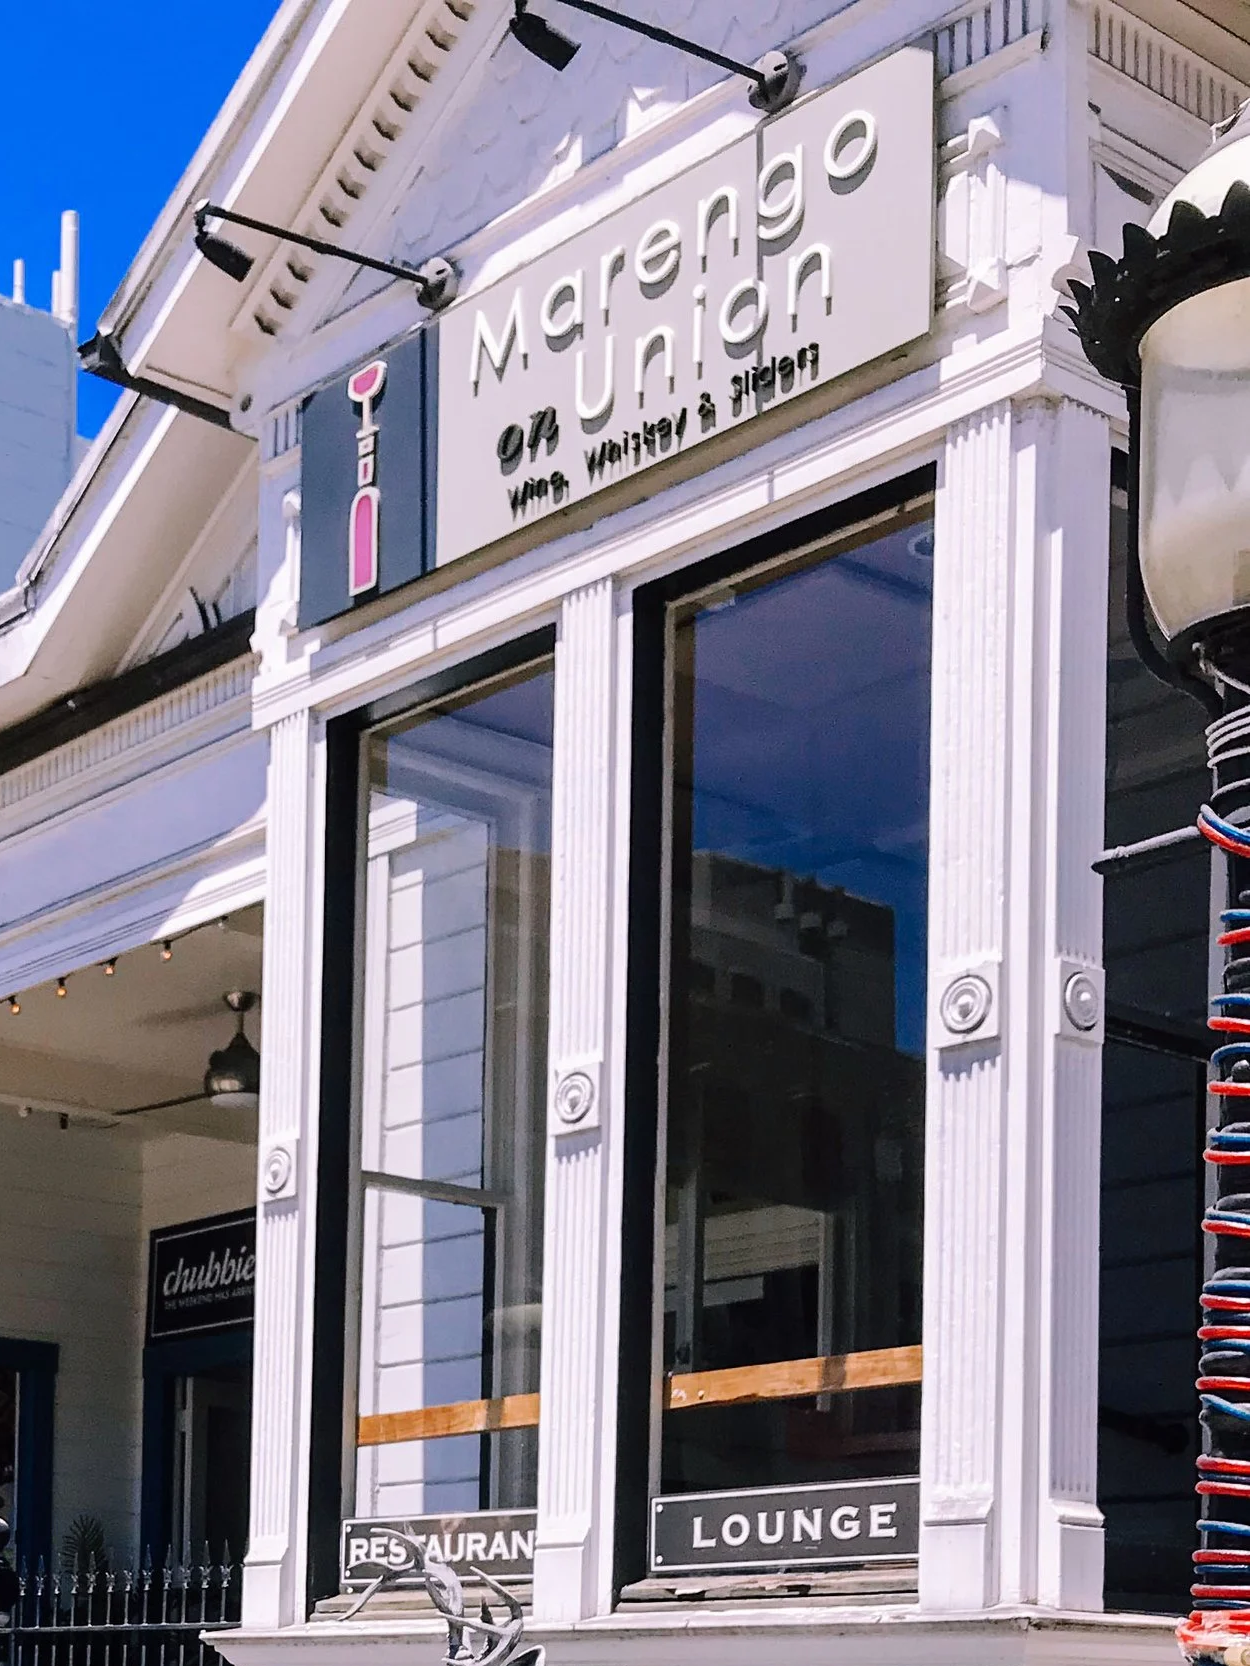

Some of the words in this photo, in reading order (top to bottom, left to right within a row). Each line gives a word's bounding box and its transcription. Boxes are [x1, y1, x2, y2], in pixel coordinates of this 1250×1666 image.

[468, 108, 878, 386] Marengo
[498, 405, 559, 470] on
[574, 243, 832, 421] Union
[584, 407, 687, 480] Whiskey
[699, 391, 717, 426] &
[692, 1501, 899, 1550] LOUNGE
